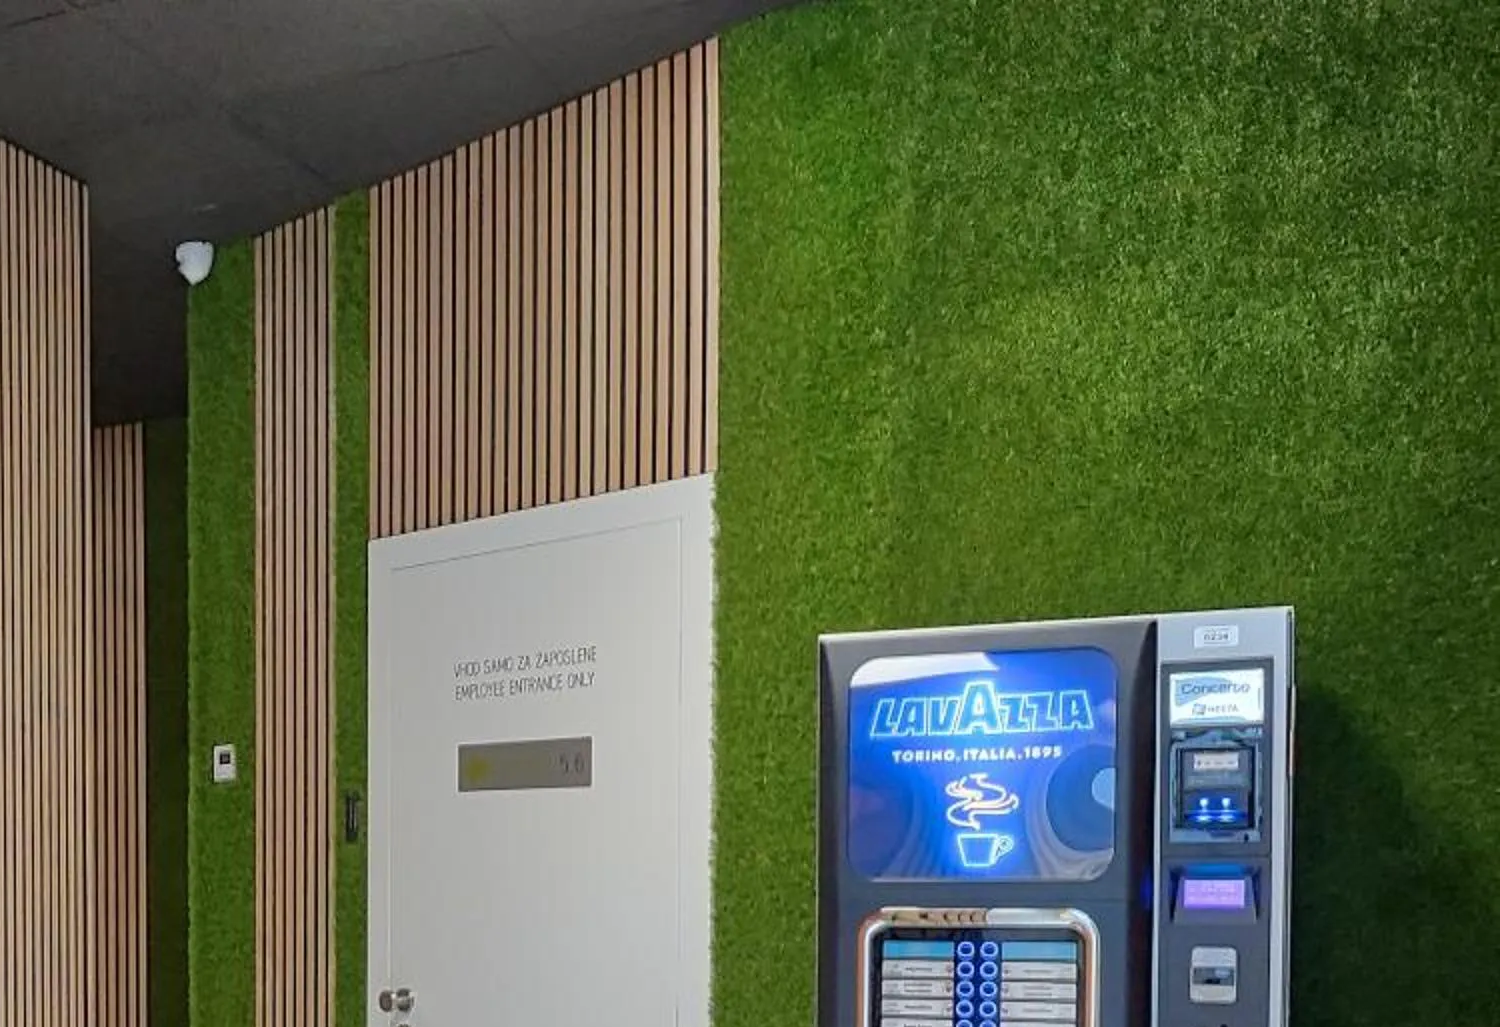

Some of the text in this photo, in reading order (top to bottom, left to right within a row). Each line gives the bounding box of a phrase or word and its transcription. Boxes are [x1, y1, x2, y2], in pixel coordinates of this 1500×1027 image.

[453, 645, 596, 678] VHOD SAMO ZA ZAPOSLENE
[455, 671, 596, 701] EMPLOYEE ENTRANCE ONLY
[870, 680, 1094, 737] LAVAZZA
